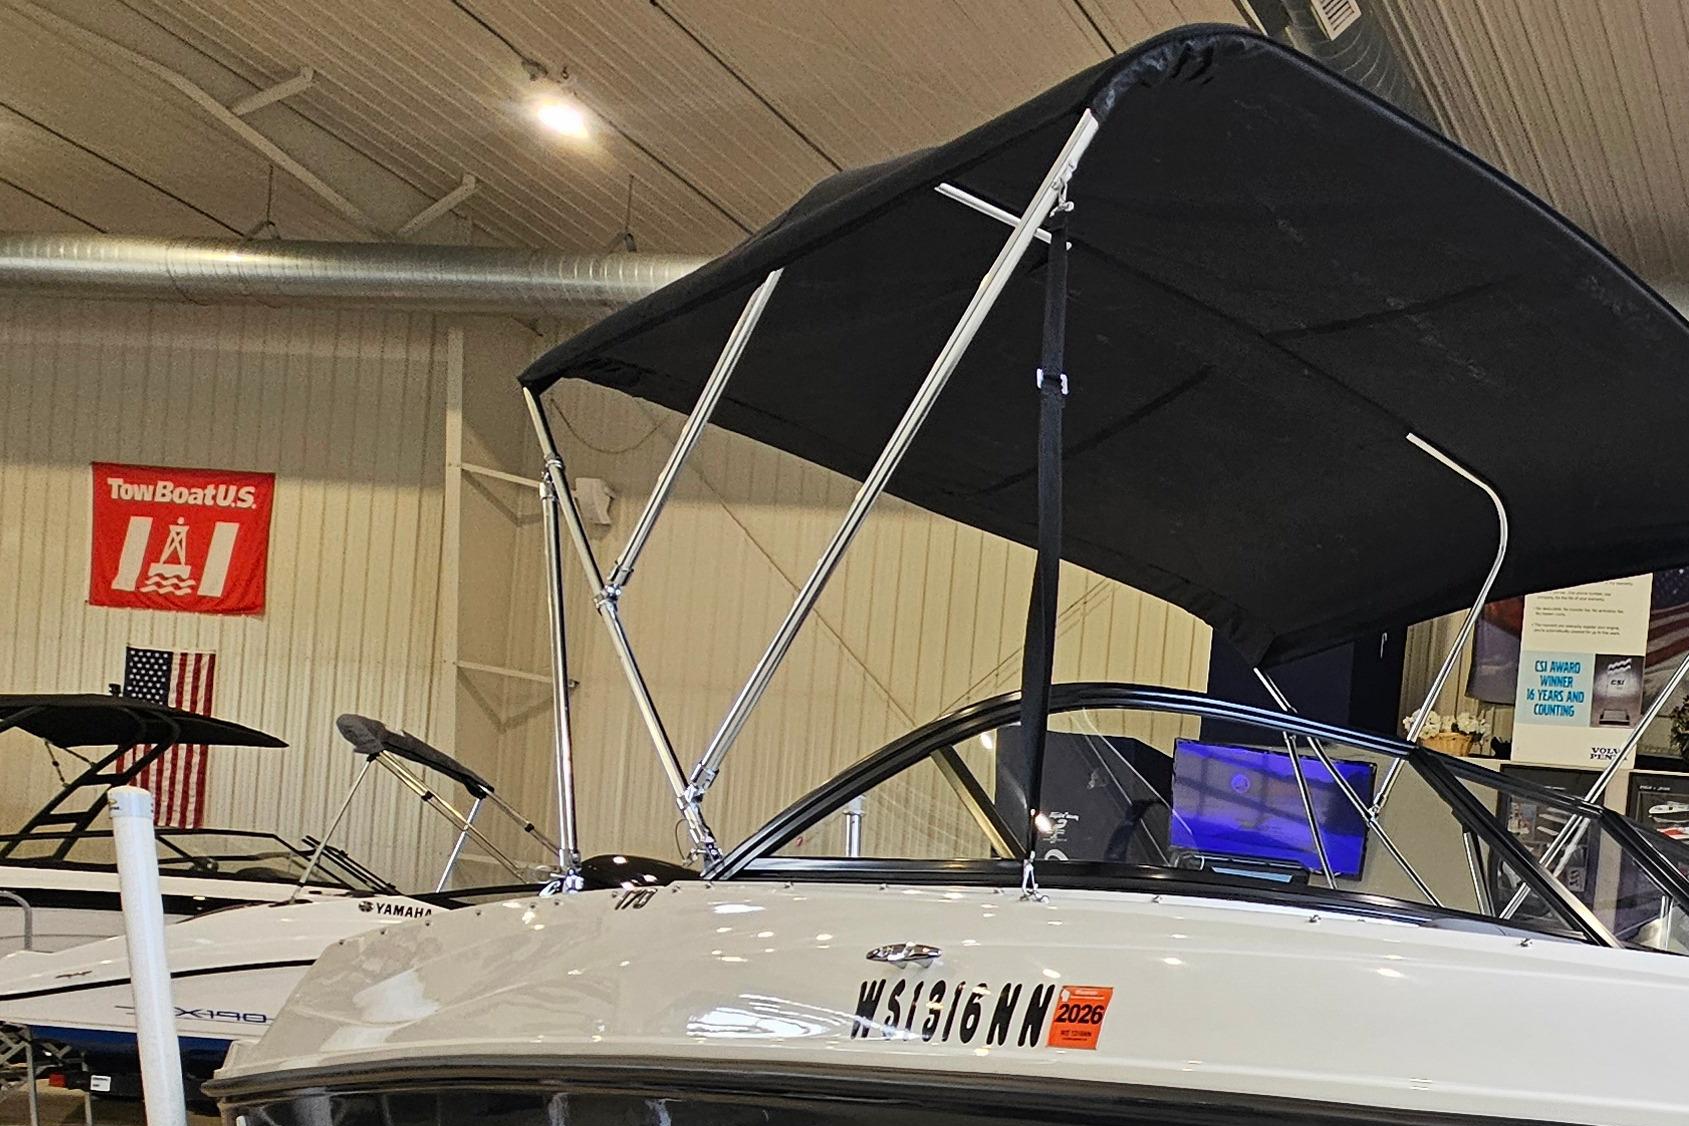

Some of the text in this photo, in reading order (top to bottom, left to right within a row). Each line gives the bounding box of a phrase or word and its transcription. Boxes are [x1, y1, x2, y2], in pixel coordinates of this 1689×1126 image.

[1534, 660, 1581, 674] CSI AWARD
[1540, 675, 1574, 688] WINNER
[1538, 690, 1564, 702] YEARS
[1566, 691, 1585, 704] AND
[1533, 704, 1575, 717] COUNTING
[376, 902, 432, 919] YAMAHA
[1054, 1003, 1105, 1025] 2026
